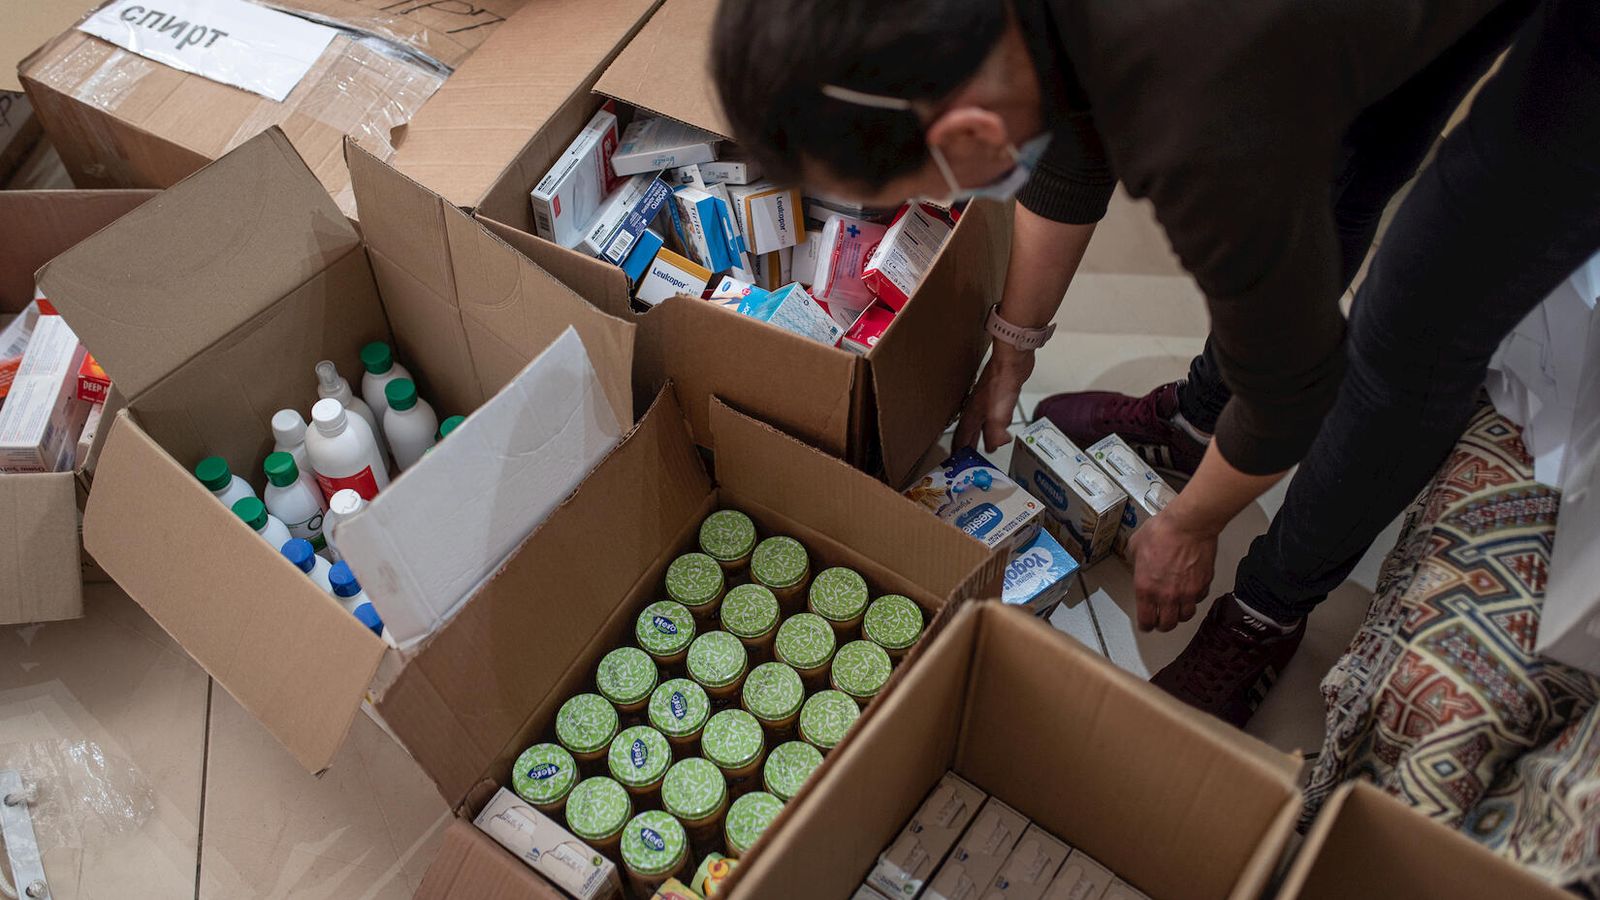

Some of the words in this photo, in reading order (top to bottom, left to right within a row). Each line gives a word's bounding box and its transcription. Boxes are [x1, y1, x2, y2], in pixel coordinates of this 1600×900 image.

[118, 4, 230, 51] спирт
[776, 196, 787, 233] Leukopor
[652, 267, 689, 290] Leukopor
[82, 380, 102, 391] DEEP
[654, 616, 675, 631] Hero
[671, 695, 683, 716] Hero
[632, 742, 642, 765] Hero
[531, 766, 555, 778] Hero
[641, 828, 662, 847] Hero
